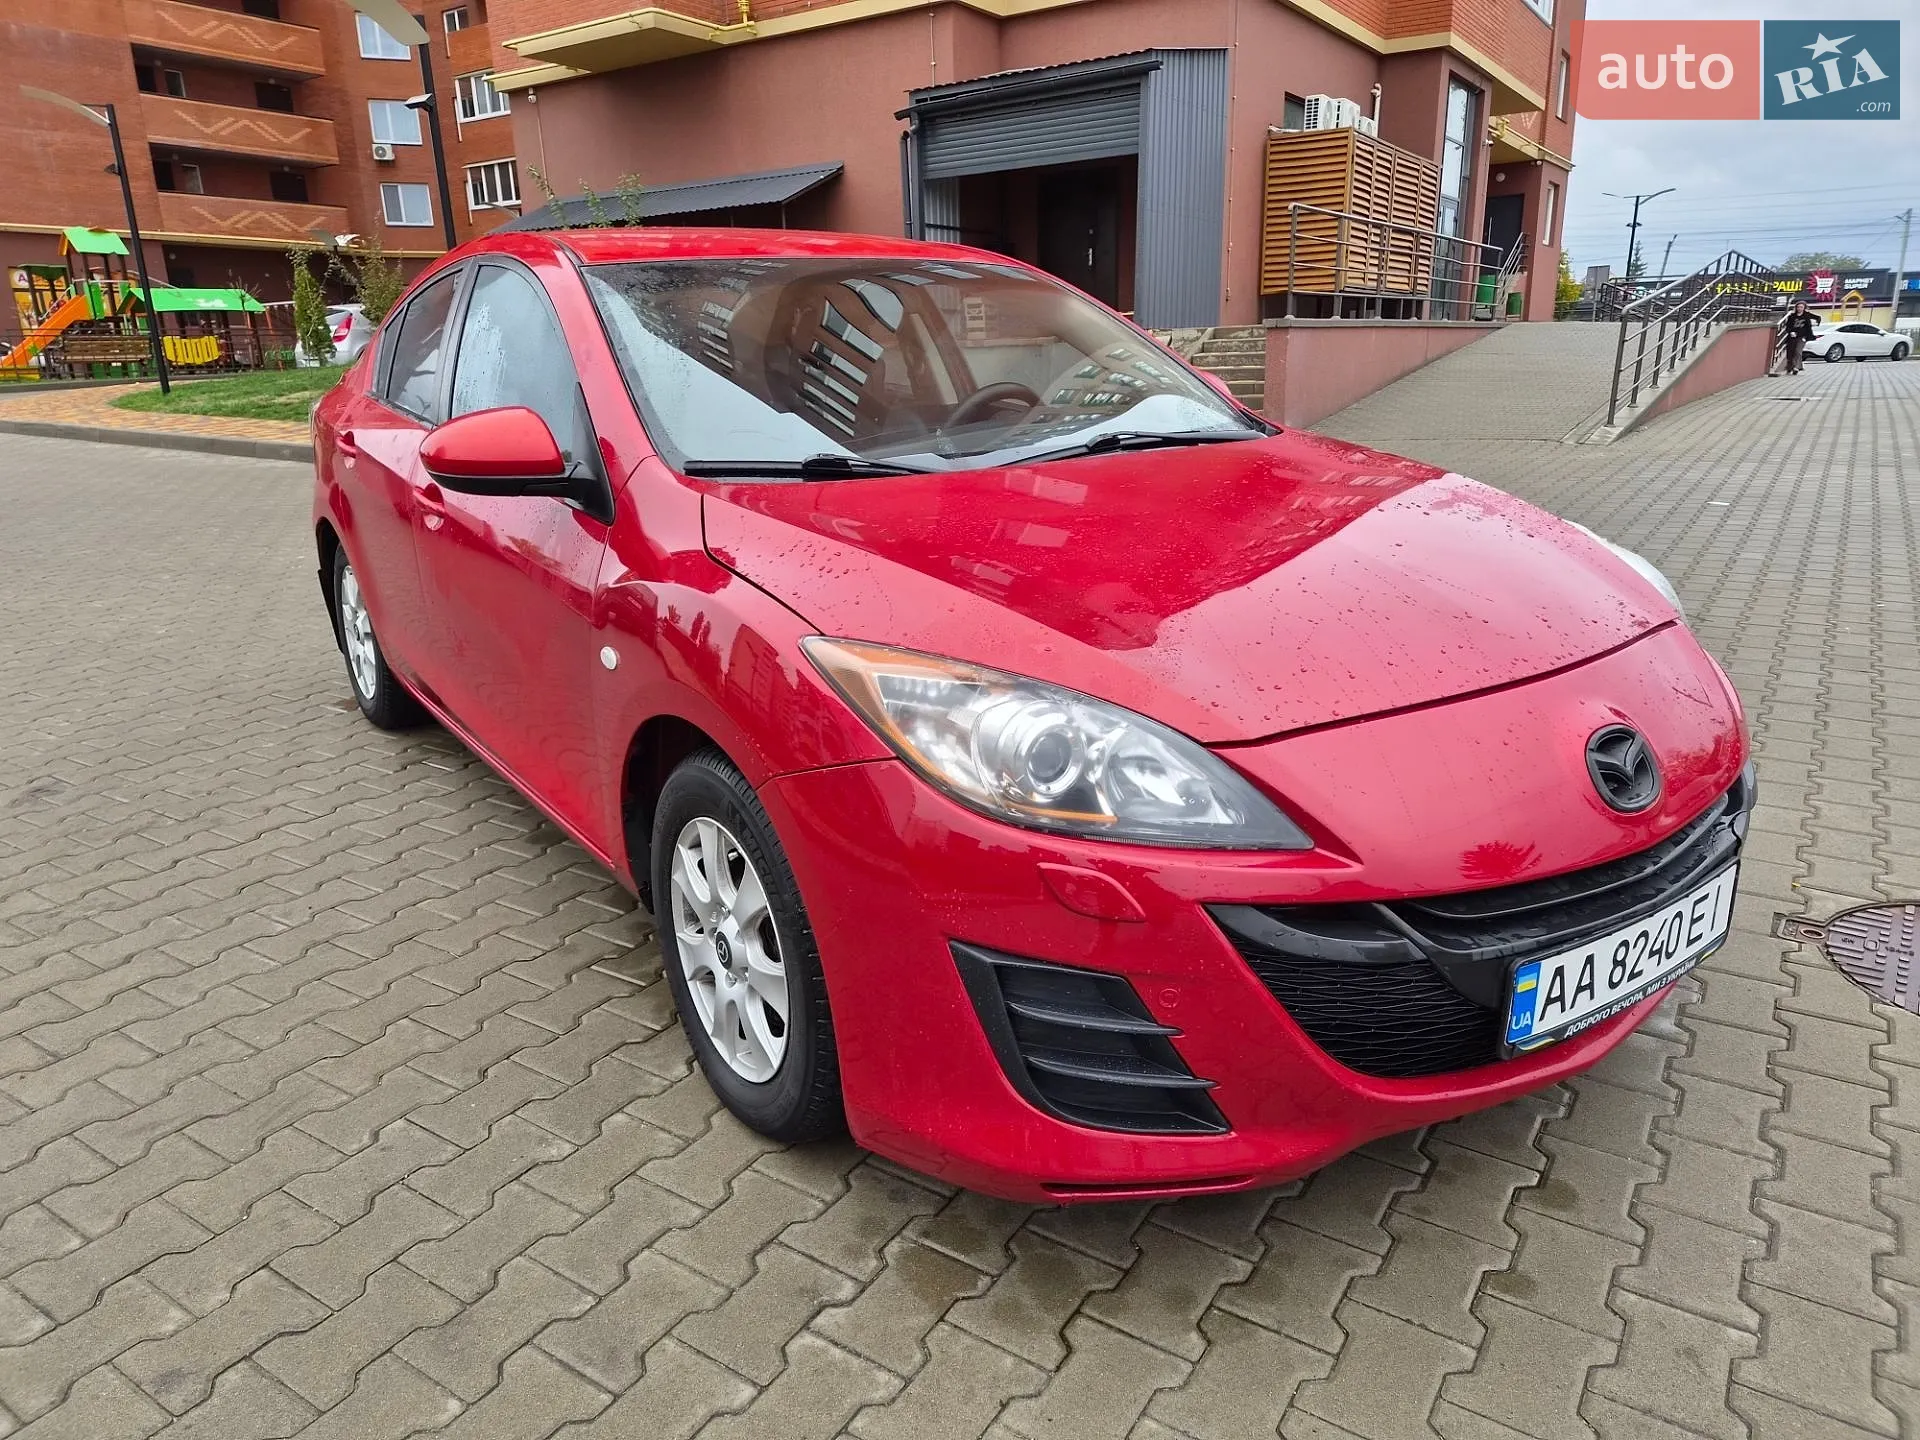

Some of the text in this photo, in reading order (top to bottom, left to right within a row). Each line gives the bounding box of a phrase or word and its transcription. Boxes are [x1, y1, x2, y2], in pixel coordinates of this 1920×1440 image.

[1538, 953, 1595, 1022] AA
[1607, 910, 1684, 990] 8240
[1511, 1011, 1532, 1030] UA
[1563, 1008, 1609, 1039] ДОБРОГО
